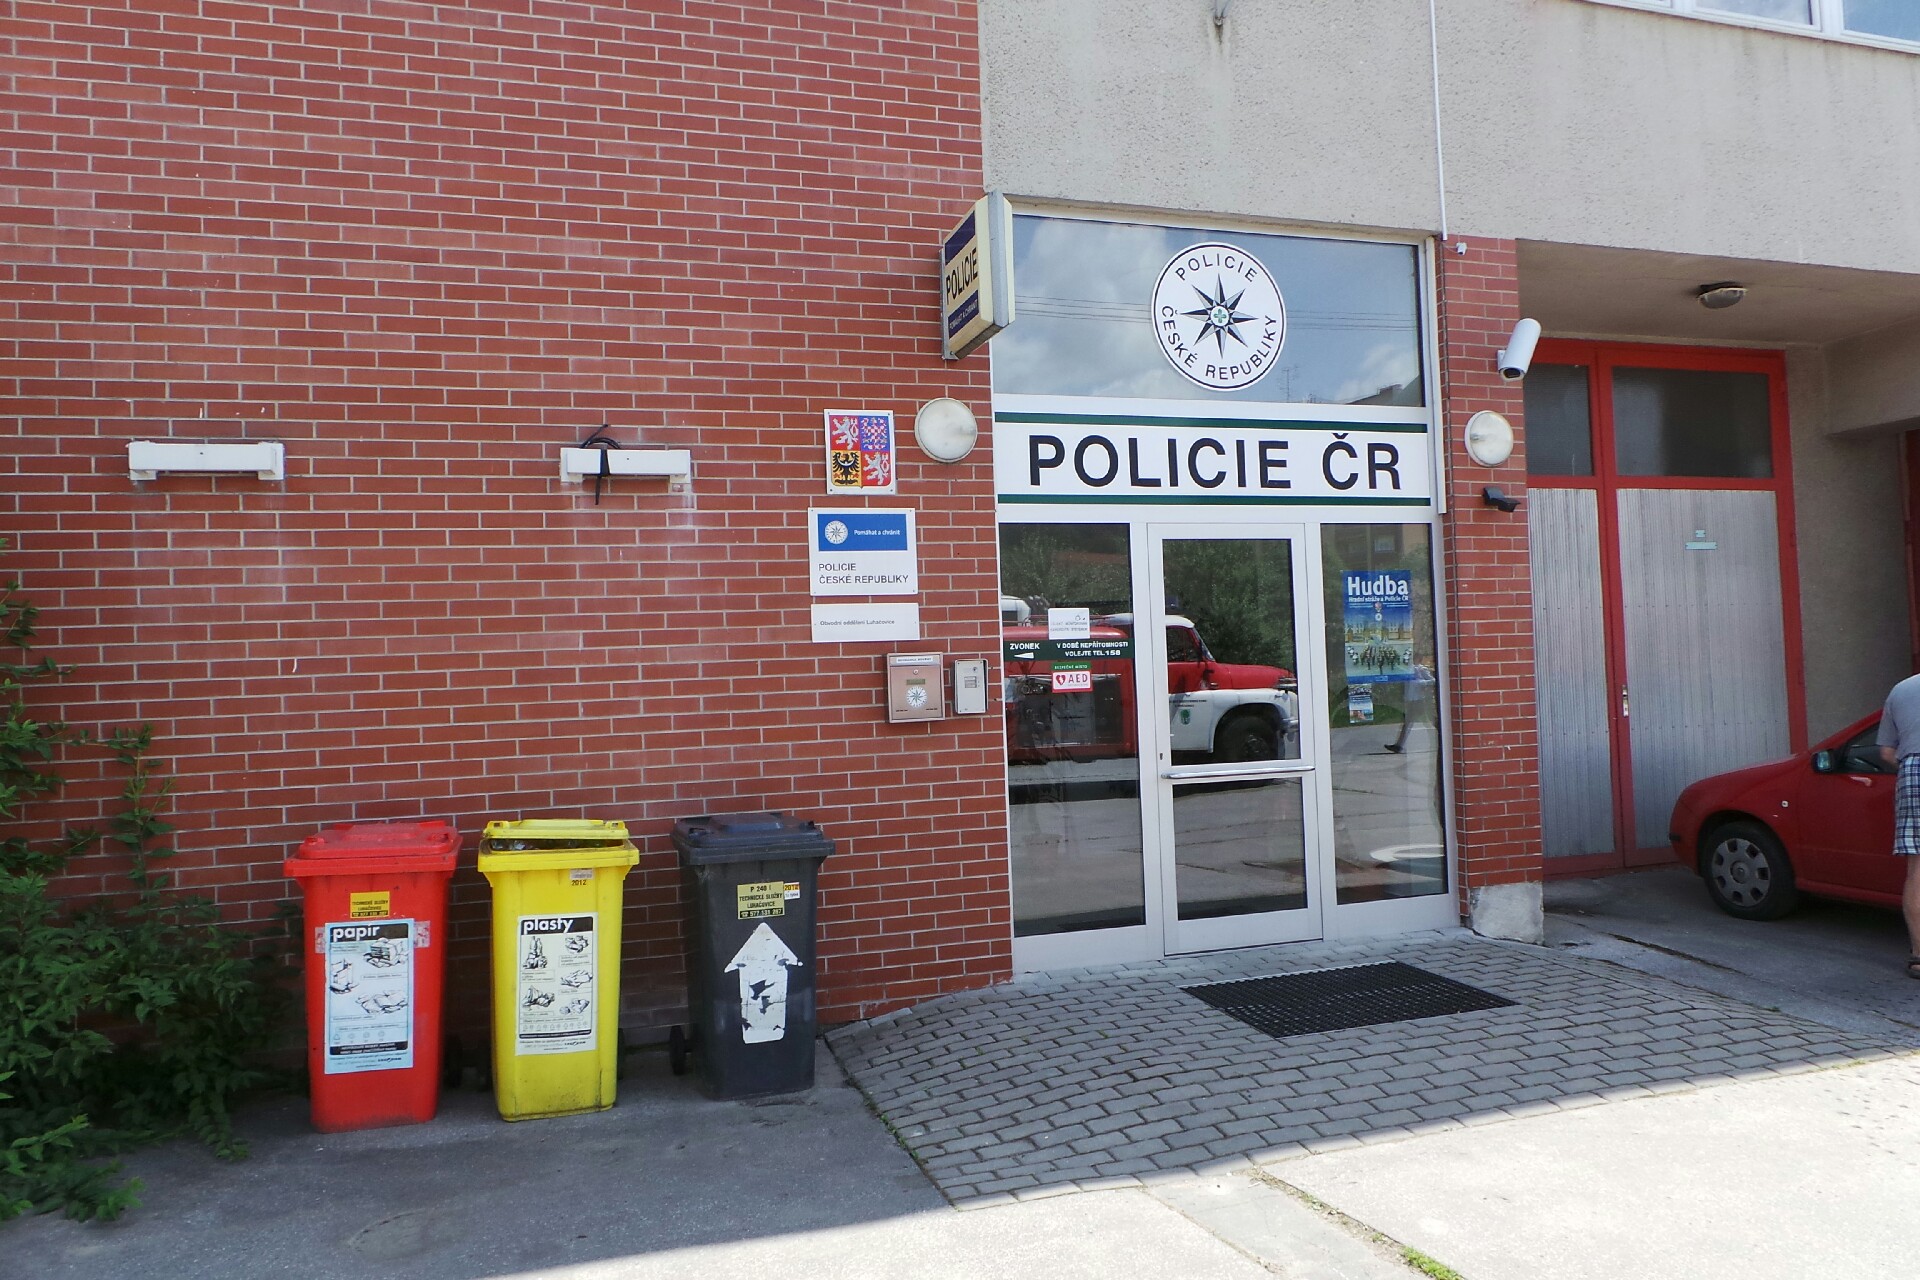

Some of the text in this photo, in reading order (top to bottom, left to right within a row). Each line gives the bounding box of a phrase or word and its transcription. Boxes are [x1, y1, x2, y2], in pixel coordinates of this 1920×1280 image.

[946, 247, 978, 305] POLICIE
[1175, 253, 1258, 282] POLICIE
[1161, 305, 1277, 380] ČESKÉ REPUBLIKY
[1028, 432, 1402, 490] POLICIE ČR
[818, 563, 857, 572] POLICIE
[819, 574, 909, 584] ČESKÉ REPUBLIKY
[1347, 575, 1409, 596] Hudba
[1009, 642, 1040, 650] ZVONEK
[1068, 673, 1088, 683] AED
[332, 923, 380, 943] papír
[523, 918, 574, 935] plasty
